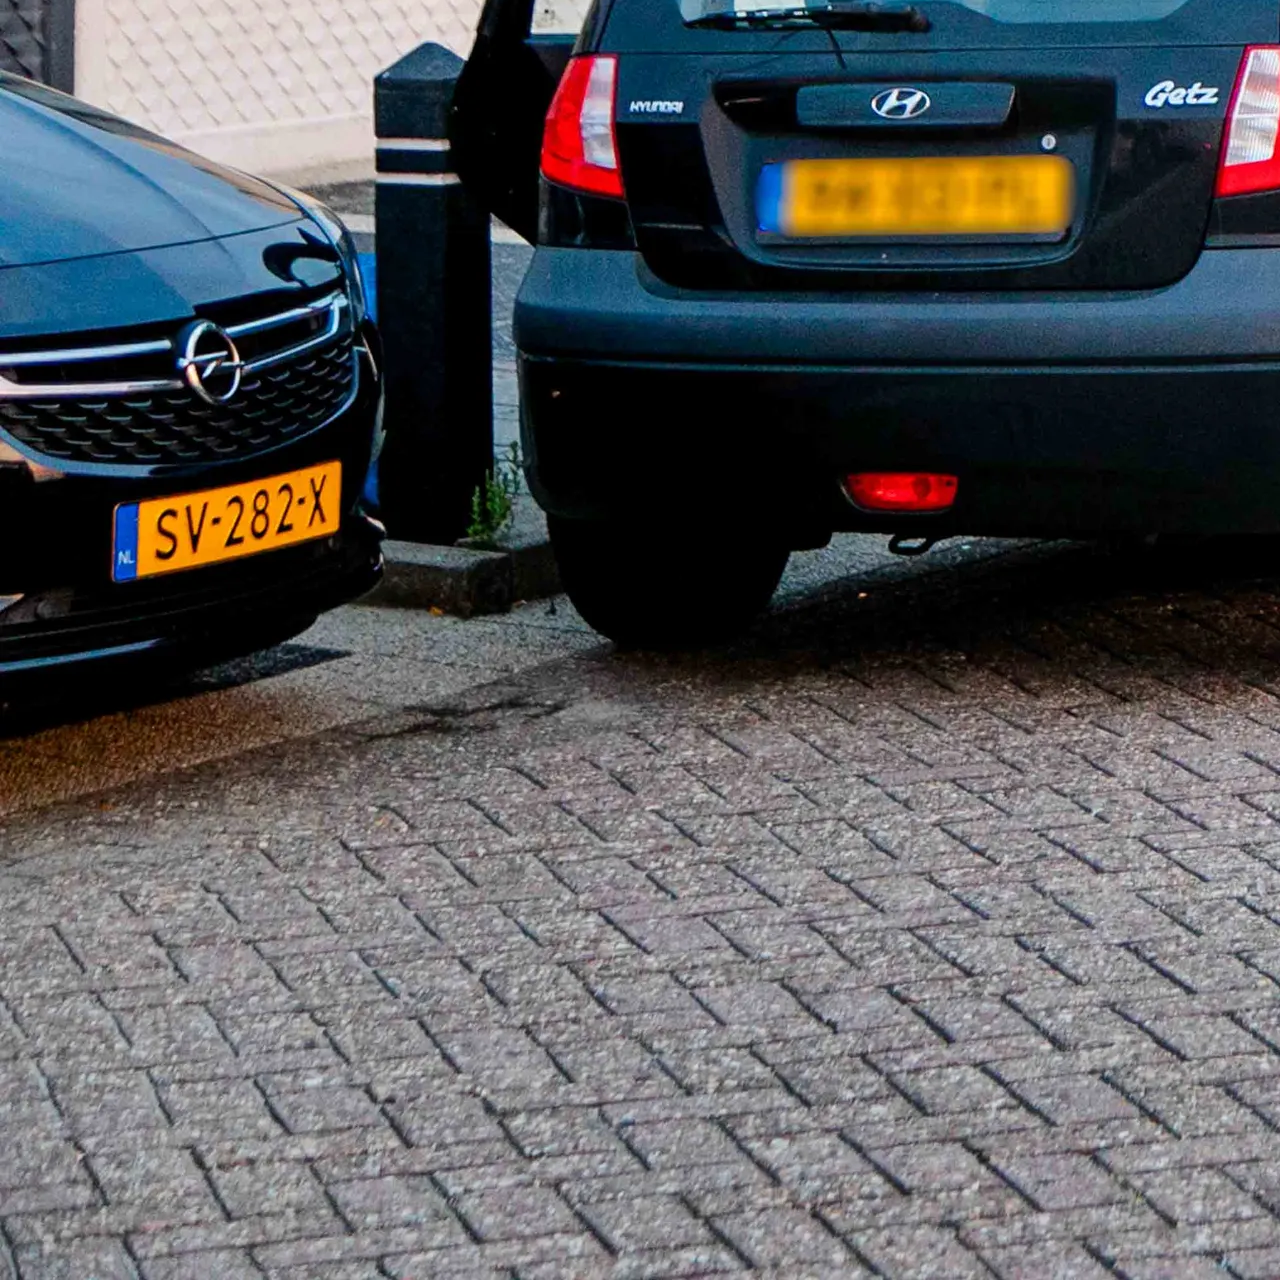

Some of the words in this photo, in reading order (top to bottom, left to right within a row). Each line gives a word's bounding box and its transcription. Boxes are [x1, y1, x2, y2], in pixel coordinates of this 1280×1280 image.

[1144, 80, 1219, 107] Getz
[629, 100, 684, 114] HYUNDAI
[154, 473, 327, 561] SV-282-X
[117, 550, 134, 565] NL
